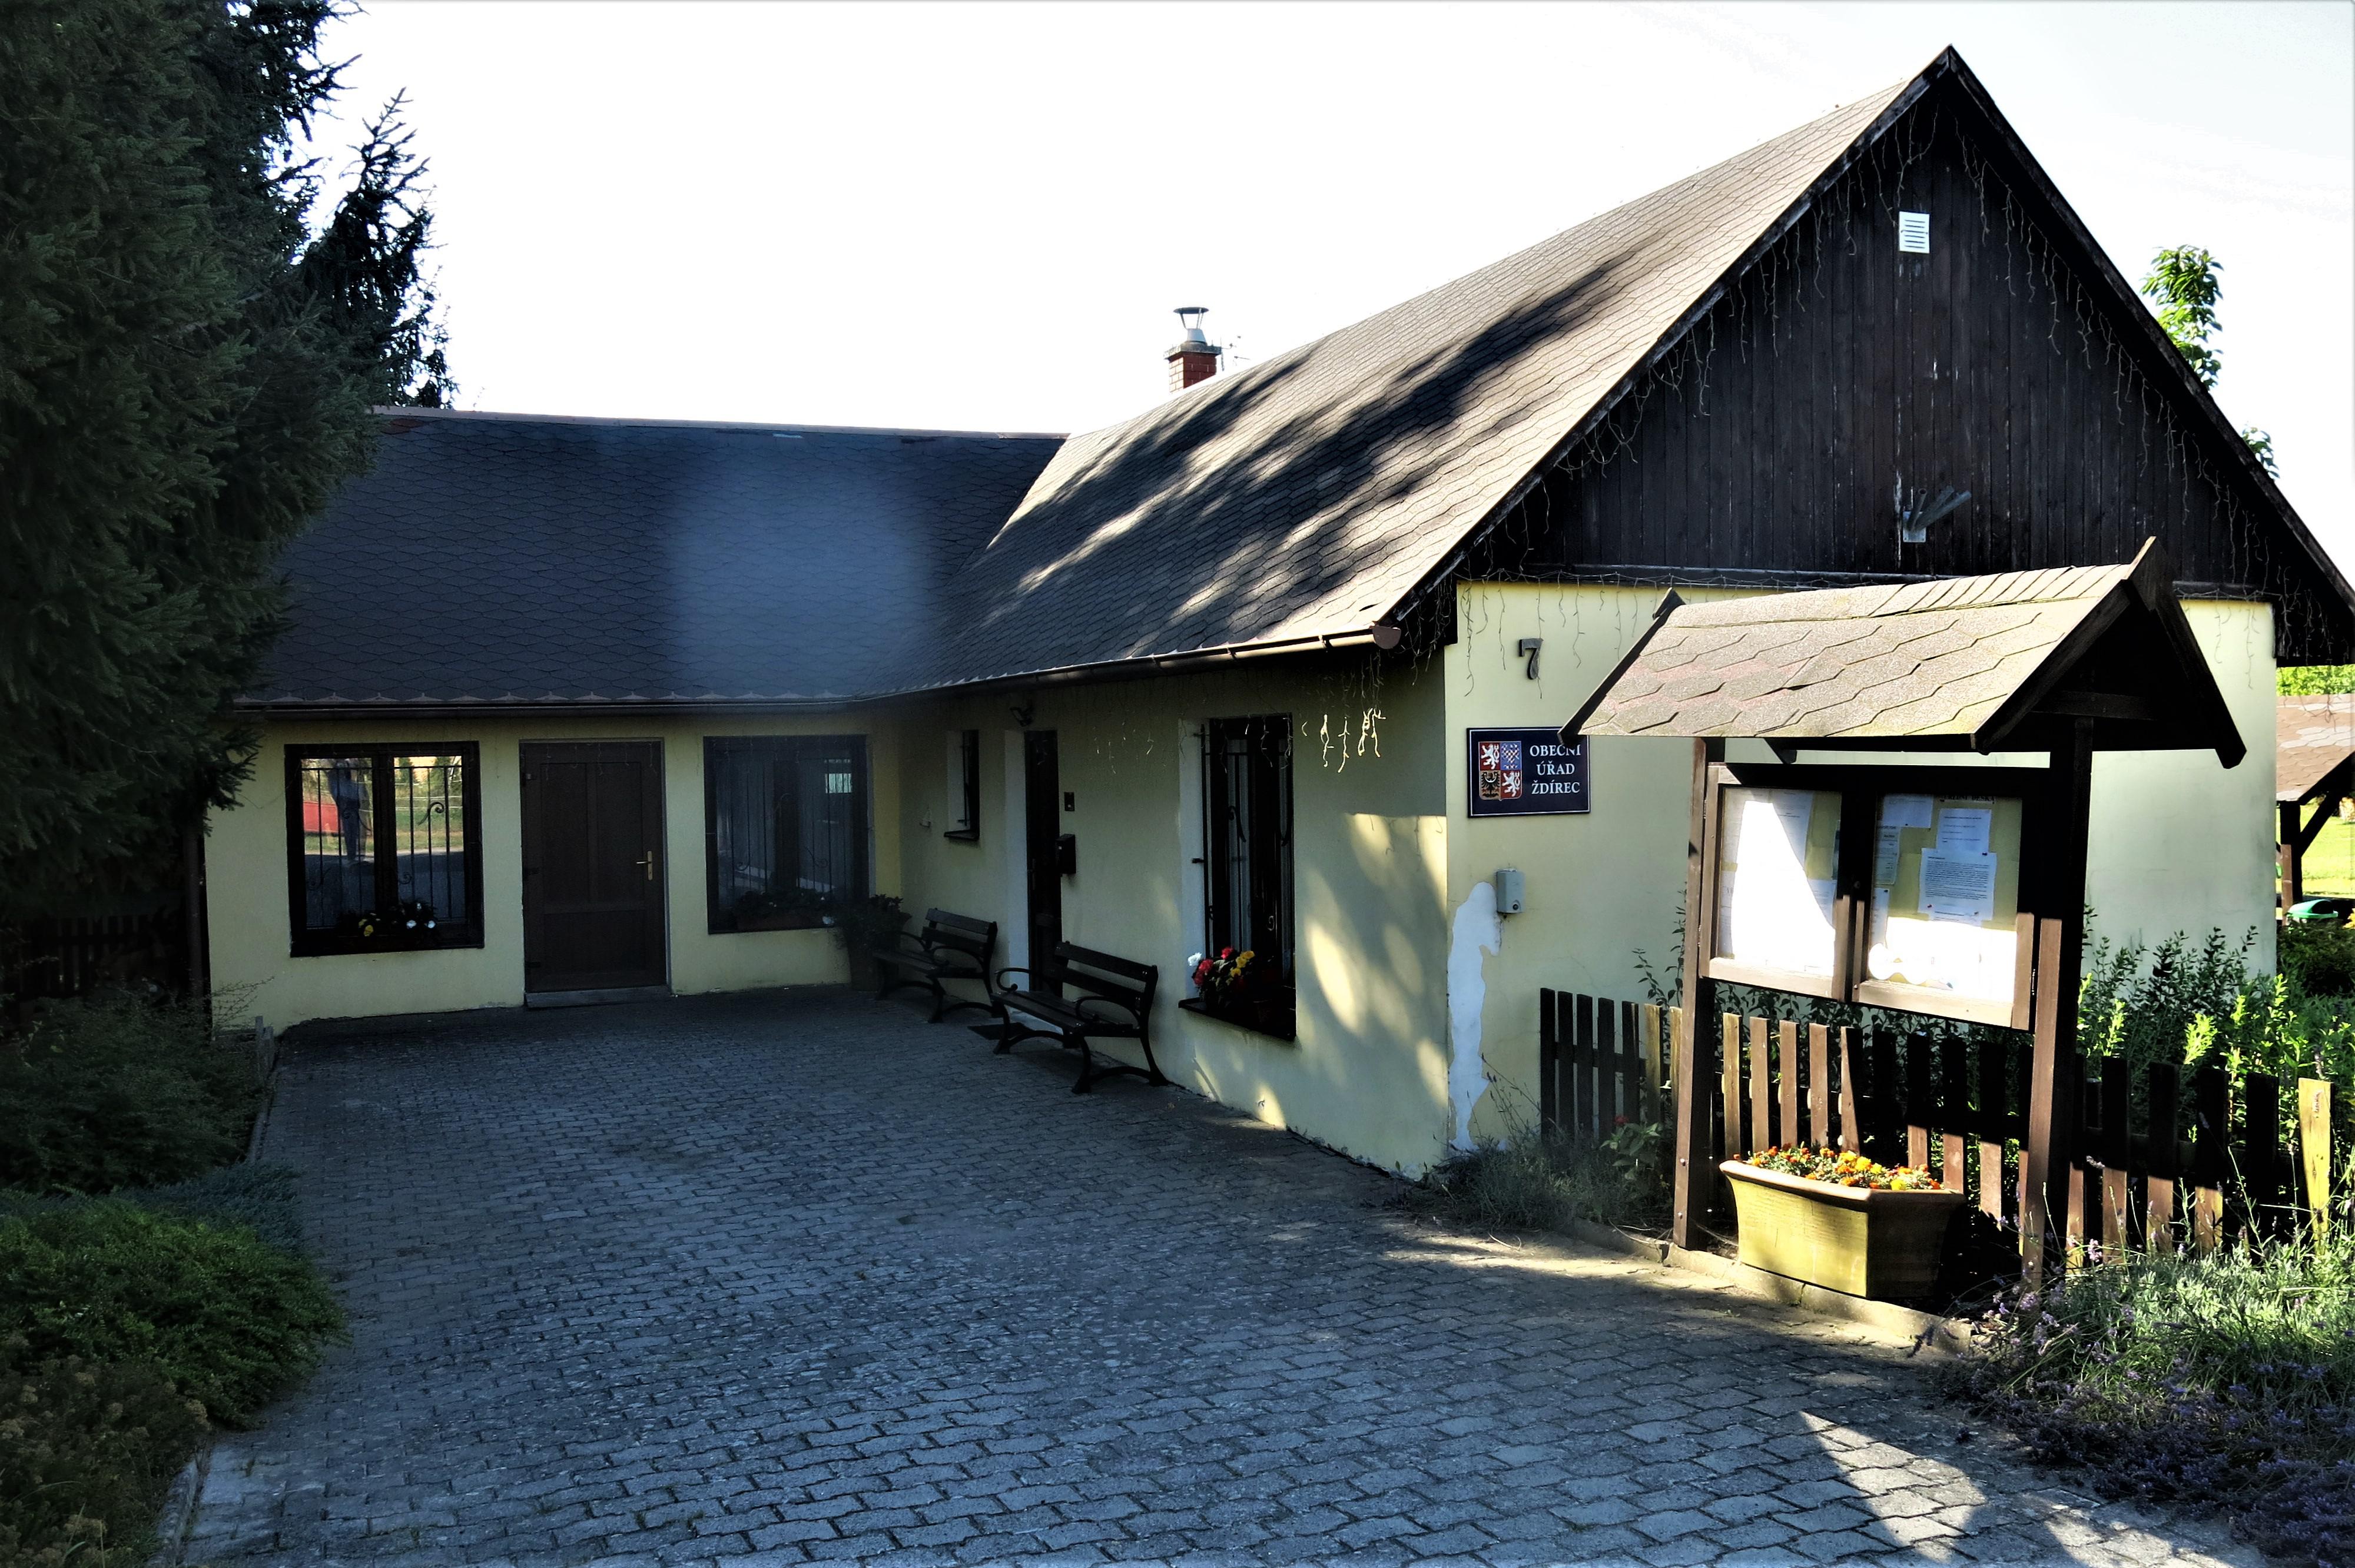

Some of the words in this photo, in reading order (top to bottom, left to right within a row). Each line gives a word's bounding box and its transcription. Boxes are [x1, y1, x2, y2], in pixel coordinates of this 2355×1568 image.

[1518, 639, 1543, 679] 7
[1536, 760, 1575, 775] ÚŘAD
[1531, 779, 1580, 794] ŽDÍREC
